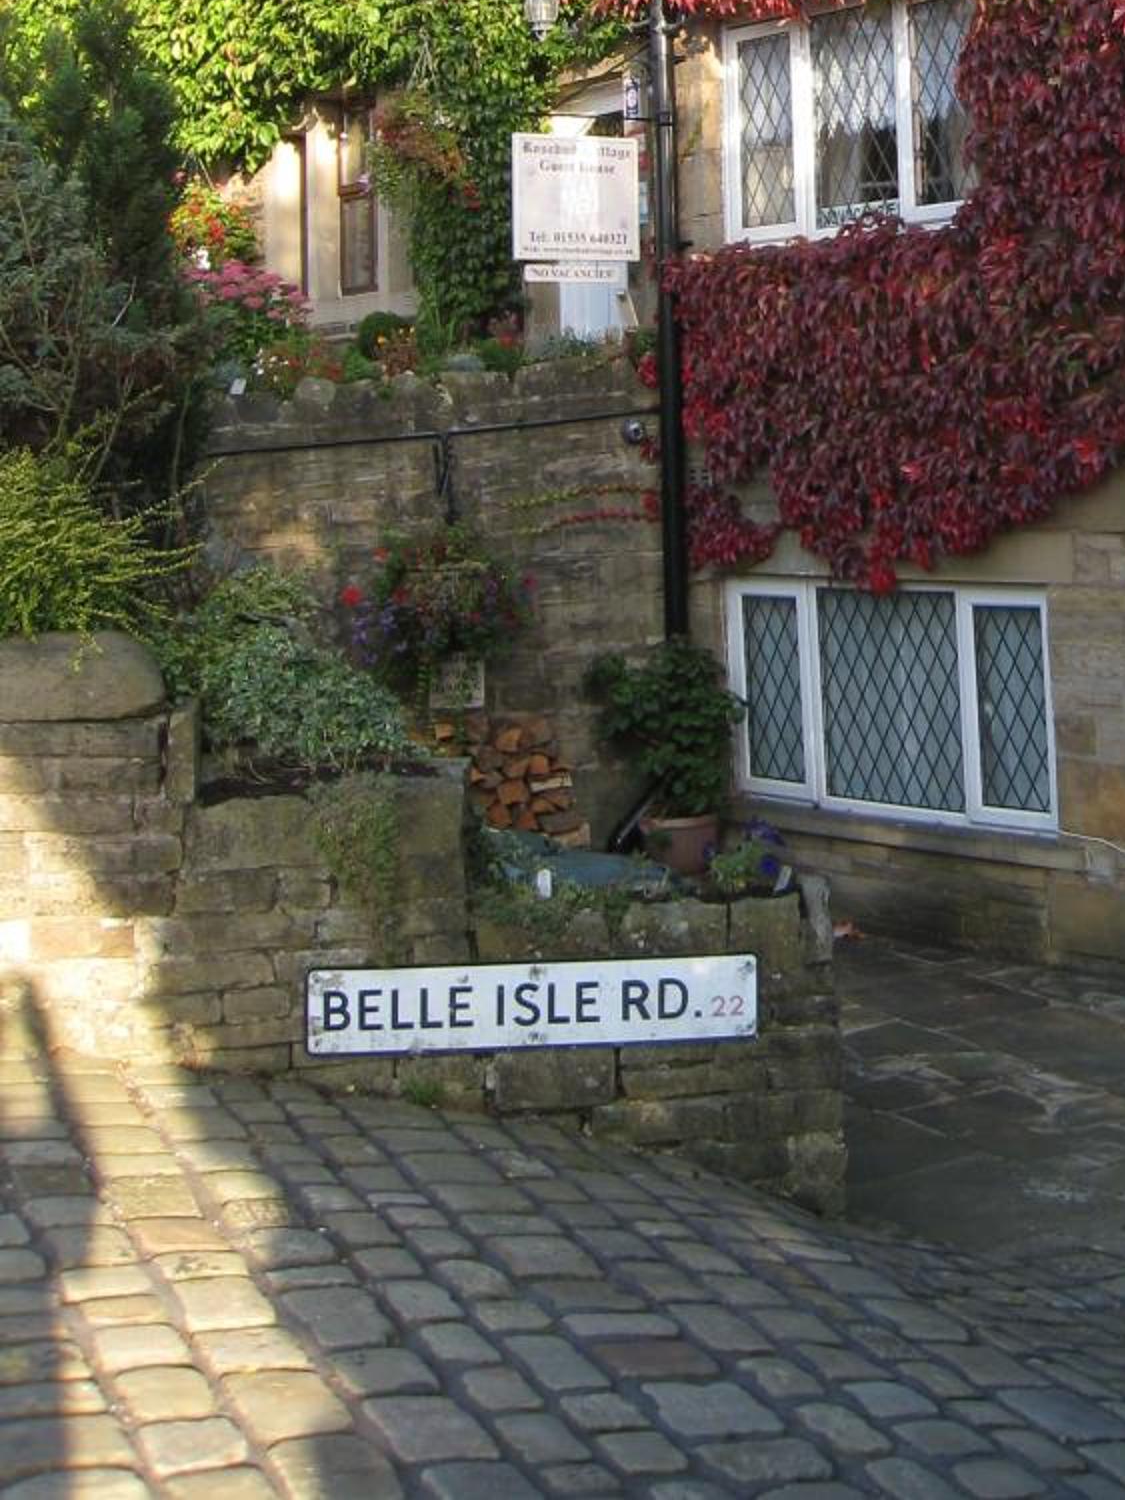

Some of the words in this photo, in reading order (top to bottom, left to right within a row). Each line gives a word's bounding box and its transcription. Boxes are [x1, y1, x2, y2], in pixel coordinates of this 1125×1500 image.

[322, 986, 475, 1032] BELLE
[496, 981, 601, 1027] ISLE
[621, 977, 703, 1022] RD.
[711, 995, 746, 1018] 22
